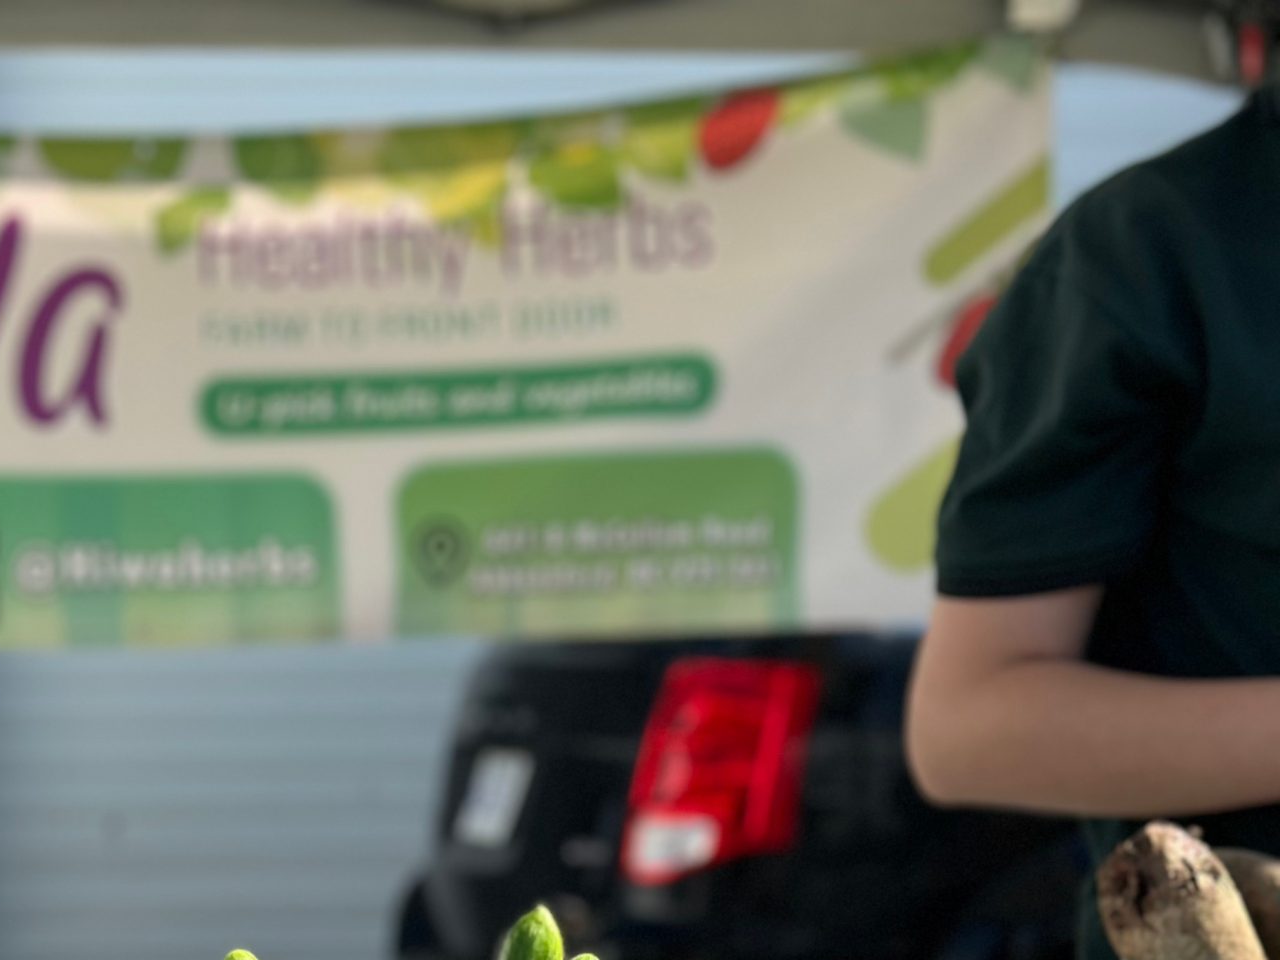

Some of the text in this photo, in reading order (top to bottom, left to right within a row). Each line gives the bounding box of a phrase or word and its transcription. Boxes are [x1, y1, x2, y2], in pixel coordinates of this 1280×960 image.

[198, 192, 716, 298] Healthy Herbs
[447, 379, 518, 413] and
